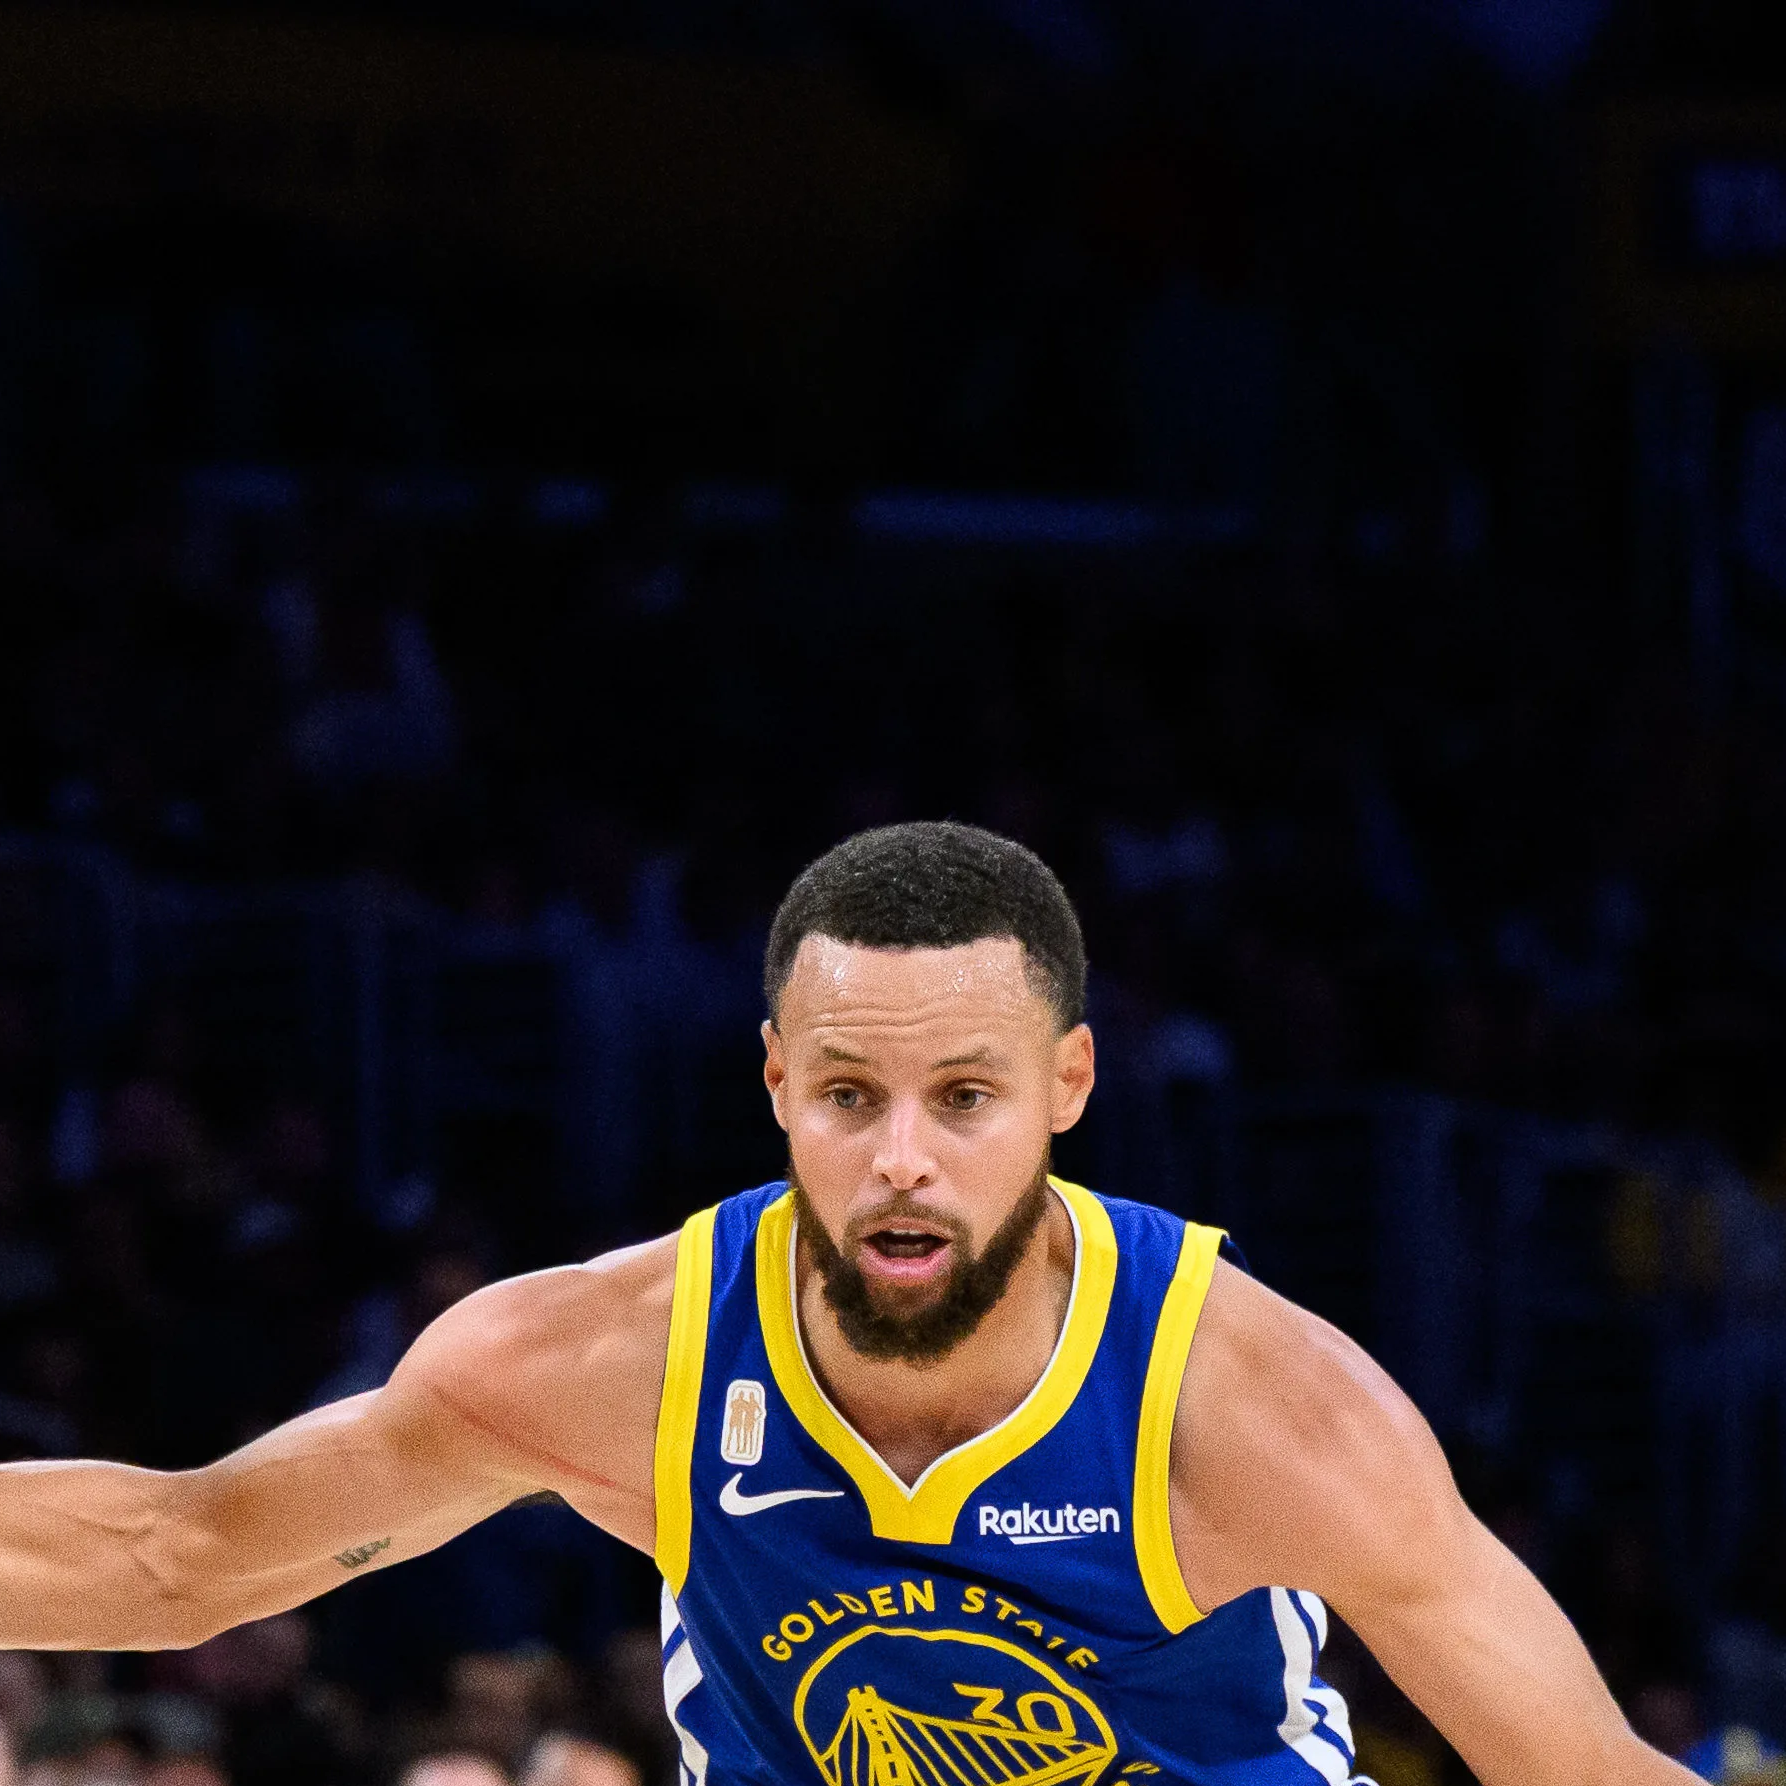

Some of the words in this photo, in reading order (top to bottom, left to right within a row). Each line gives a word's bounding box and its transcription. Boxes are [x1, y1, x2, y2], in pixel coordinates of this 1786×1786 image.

[979, 1502, 1121, 1537] Rakuten
[762, 1579, 936, 1662] GOLDEN
[952, 1682, 1077, 1738] 30
